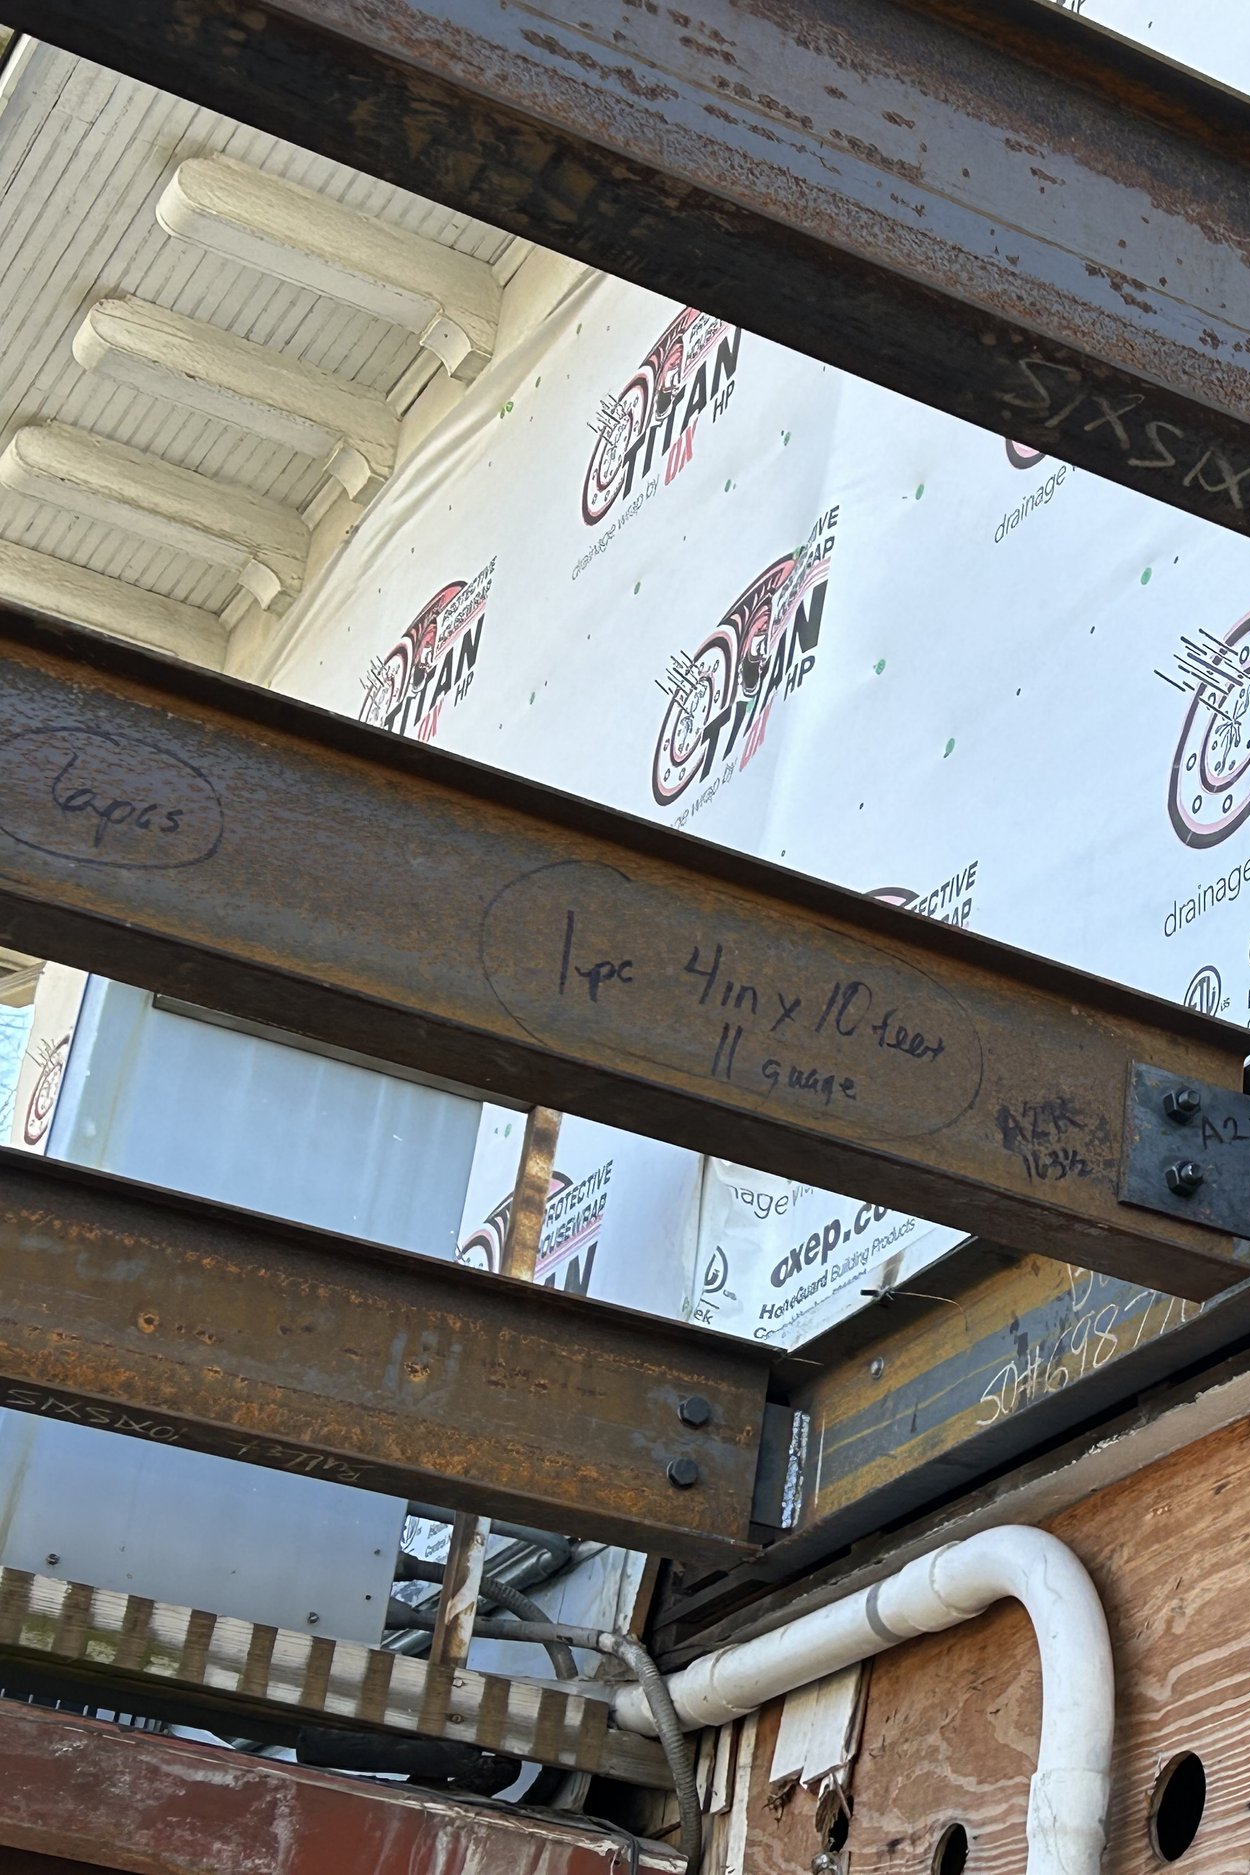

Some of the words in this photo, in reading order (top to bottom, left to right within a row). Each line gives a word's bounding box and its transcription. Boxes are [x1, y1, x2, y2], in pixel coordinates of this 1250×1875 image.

[622, 327, 742, 501] TITAN
[712, 379, 736, 424] HP
[994, 465, 1067, 544] drainage
[454, 670, 475, 708] HP
[783, 655, 816, 702] HP
[770, 1202, 894, 1288] oxep.co
